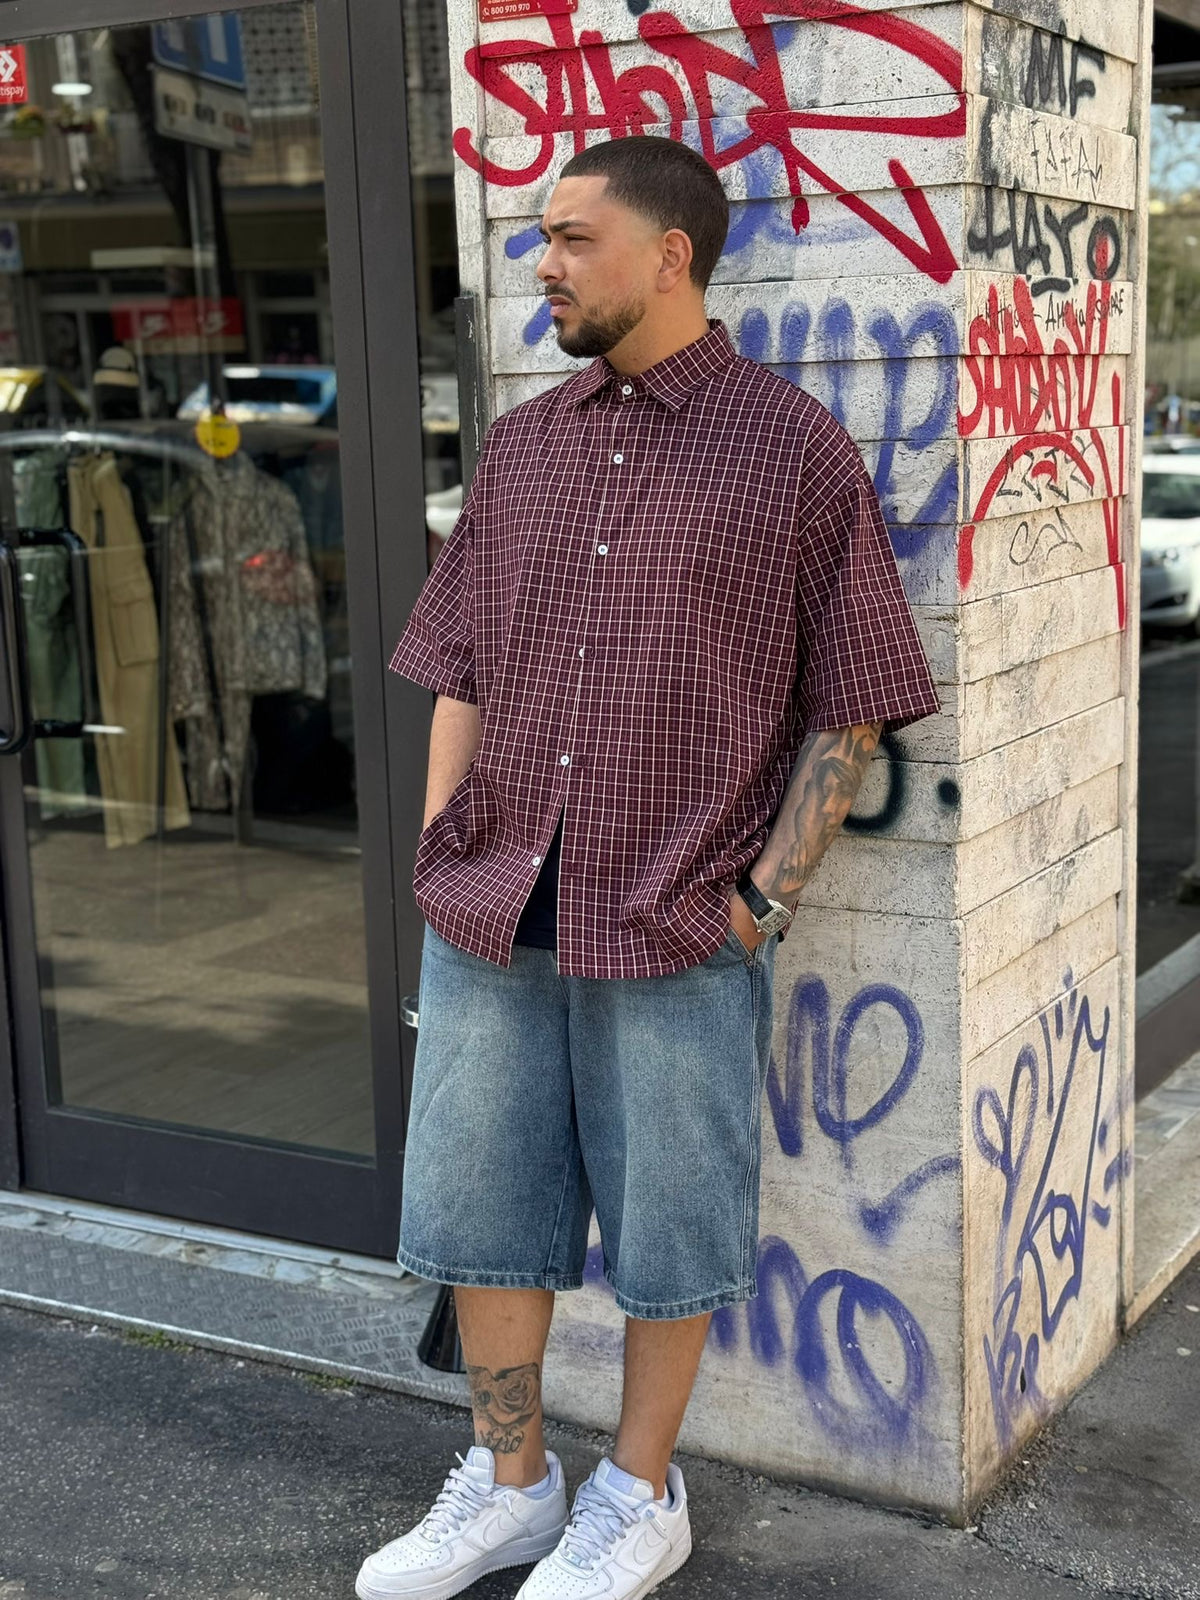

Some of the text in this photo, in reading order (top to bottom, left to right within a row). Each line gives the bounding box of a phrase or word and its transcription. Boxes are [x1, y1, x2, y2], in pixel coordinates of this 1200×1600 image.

[491, 6, 504, 15] 800
[504, 4, 517, 14] 970
[518, 3, 530, 12] 970
[0, 86, 25, 98] tispay
